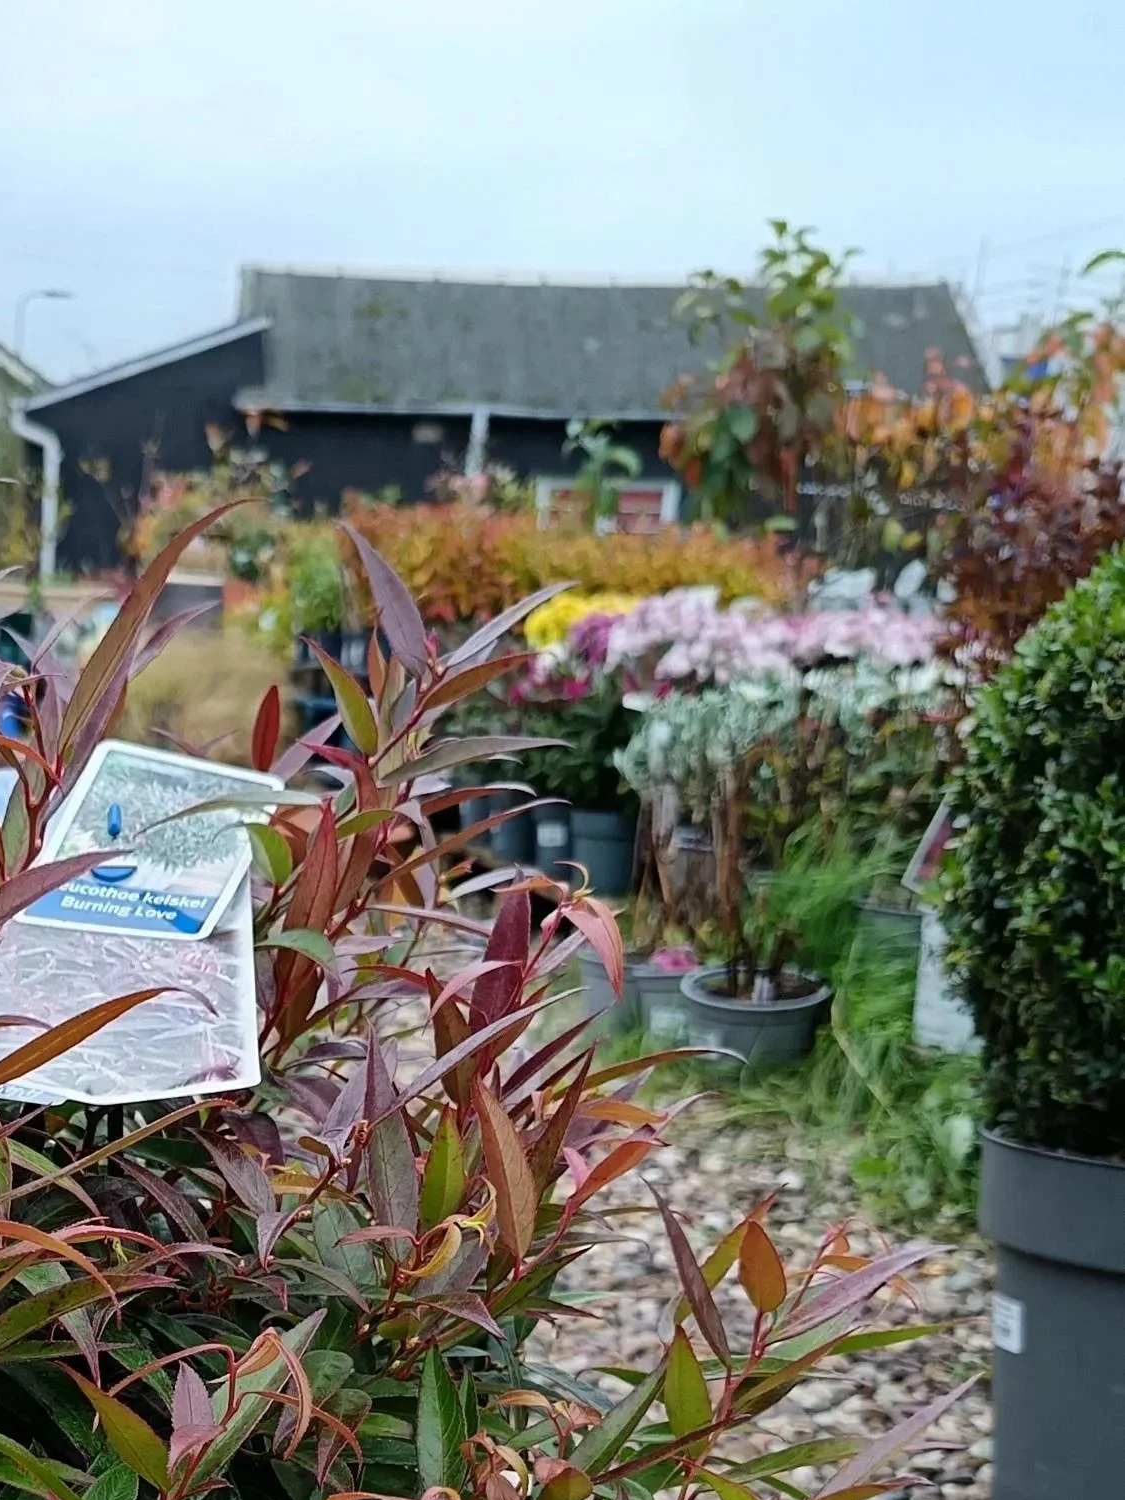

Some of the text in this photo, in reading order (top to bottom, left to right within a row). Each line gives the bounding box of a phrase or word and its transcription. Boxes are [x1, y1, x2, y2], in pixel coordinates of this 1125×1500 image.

[59, 883, 140, 901] eucothoe
[60, 896, 177, 920] Burning Love
